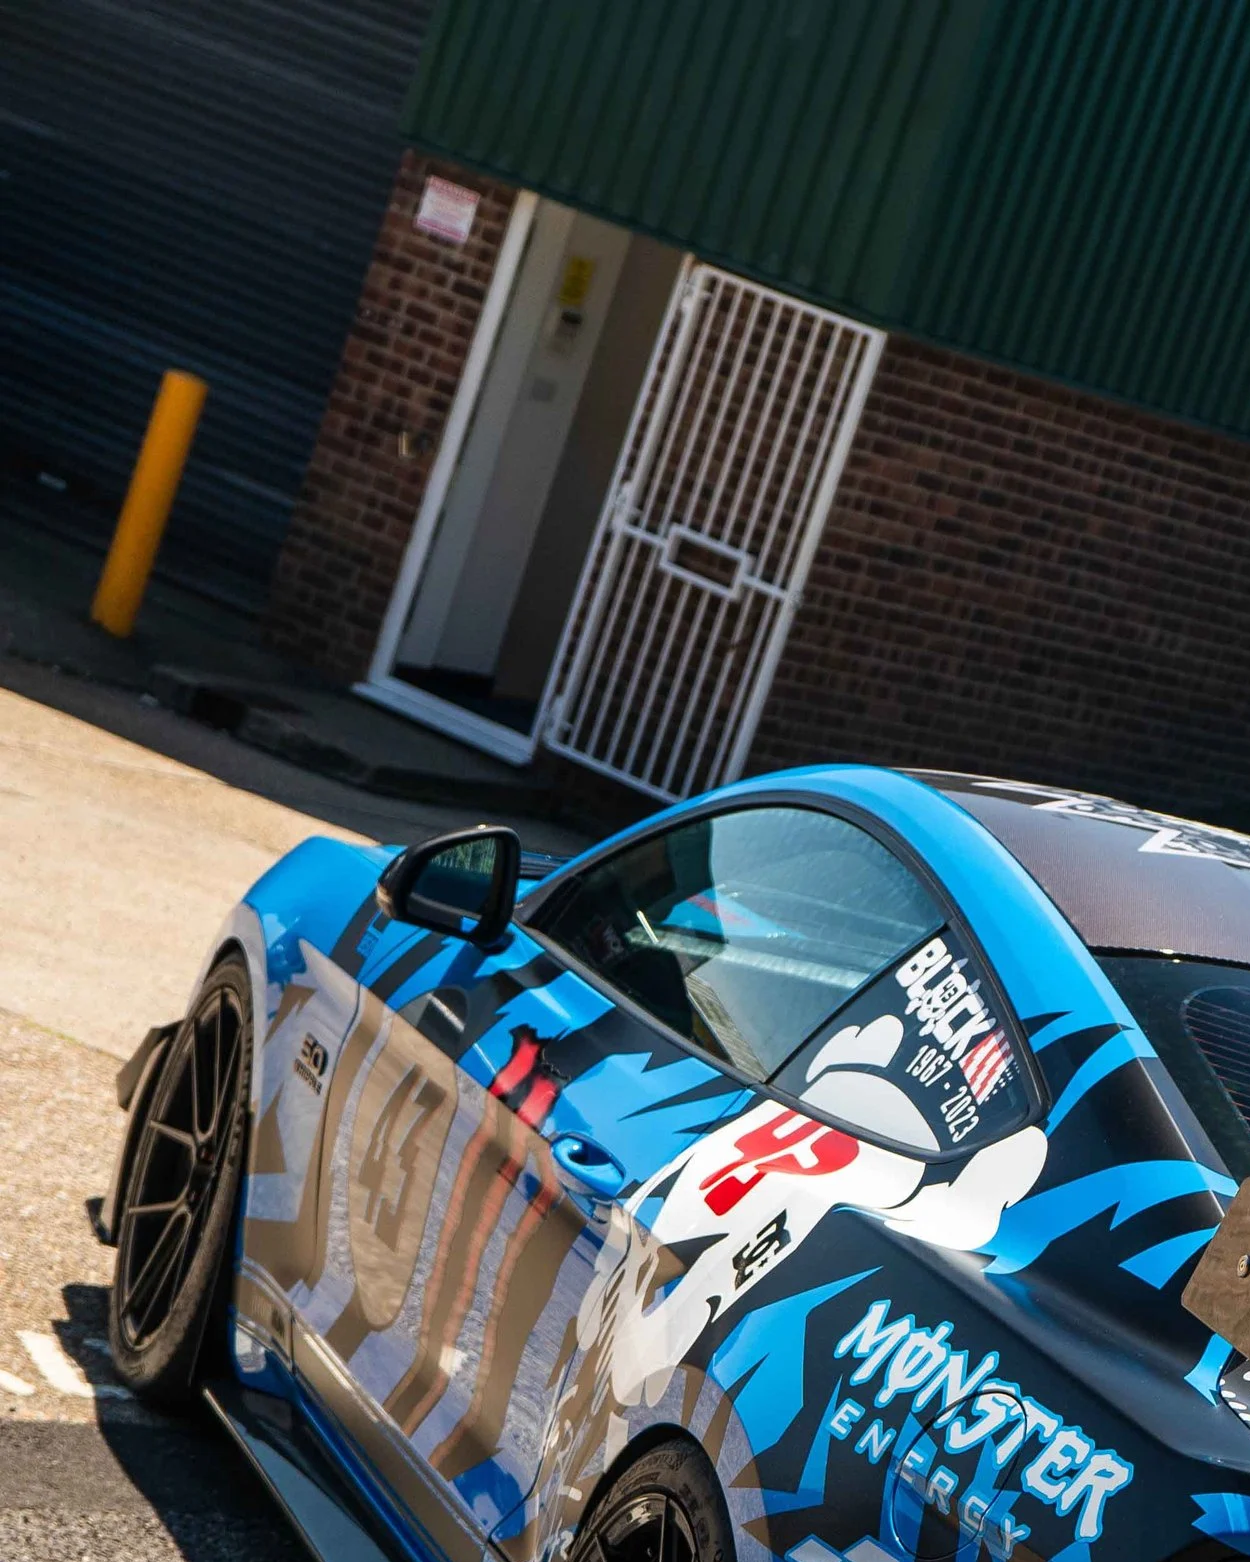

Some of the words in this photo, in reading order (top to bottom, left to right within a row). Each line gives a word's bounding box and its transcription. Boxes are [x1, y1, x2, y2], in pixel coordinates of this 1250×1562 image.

[905, 1045, 953, 1087] 1967
[940, 1086, 979, 1143] 2023
[830, 1401, 1028, 1559] ENERGY
